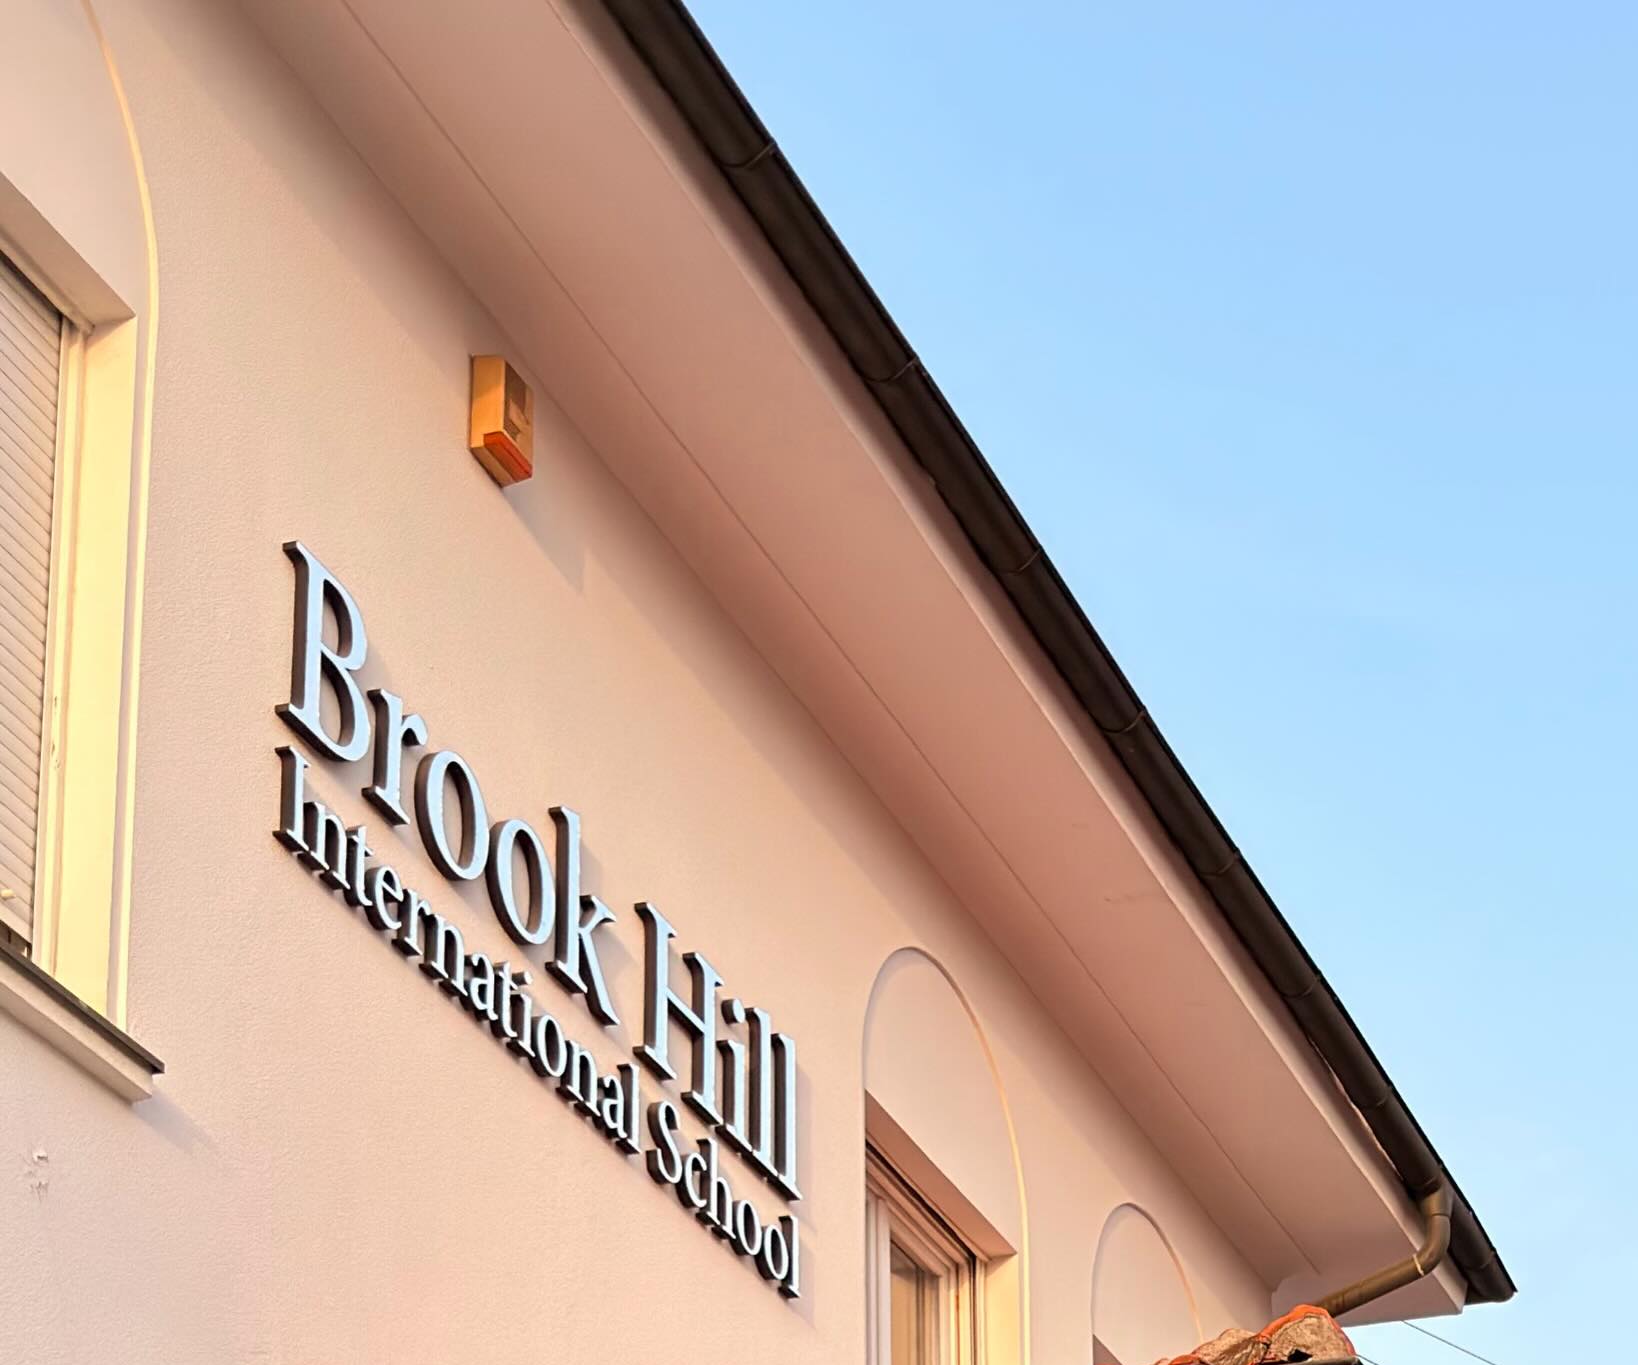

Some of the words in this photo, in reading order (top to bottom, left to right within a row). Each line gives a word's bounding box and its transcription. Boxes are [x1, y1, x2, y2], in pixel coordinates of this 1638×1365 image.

[273, 746, 642, 1156] International
[646, 1101, 801, 1299] School
[275, 541, 620, 1026] Brook
[633, 902, 802, 1200] Hill
